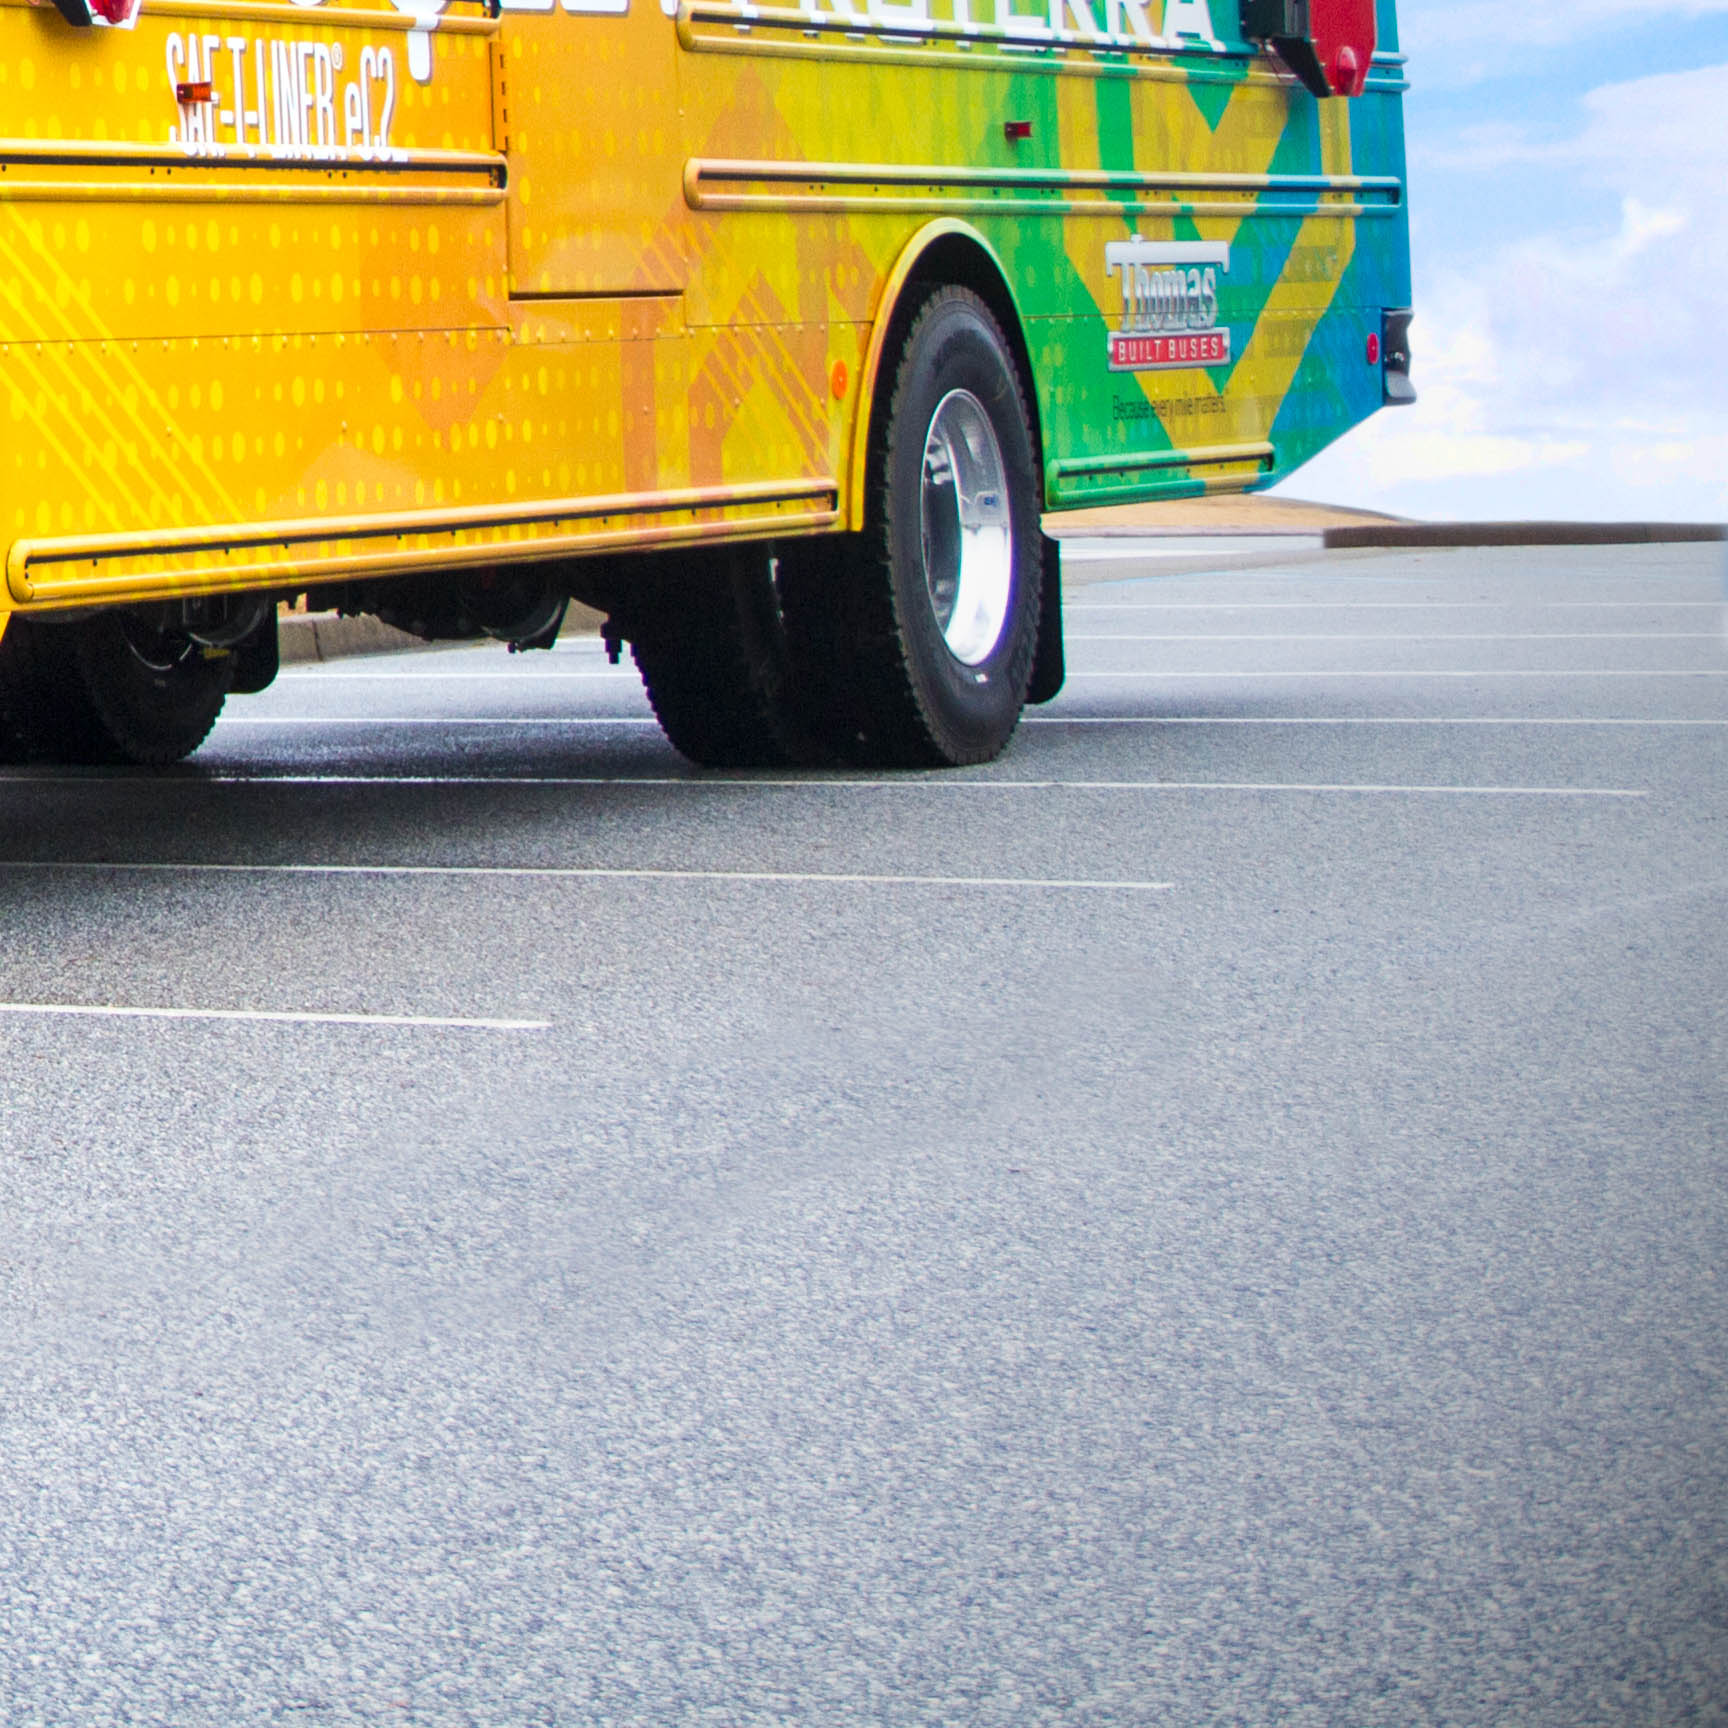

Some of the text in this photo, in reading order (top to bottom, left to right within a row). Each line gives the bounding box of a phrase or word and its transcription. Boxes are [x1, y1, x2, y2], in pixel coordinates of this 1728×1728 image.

[1105, 234, 1230, 332] Thomas
[1118, 336, 1221, 362] BUILT BUSES
